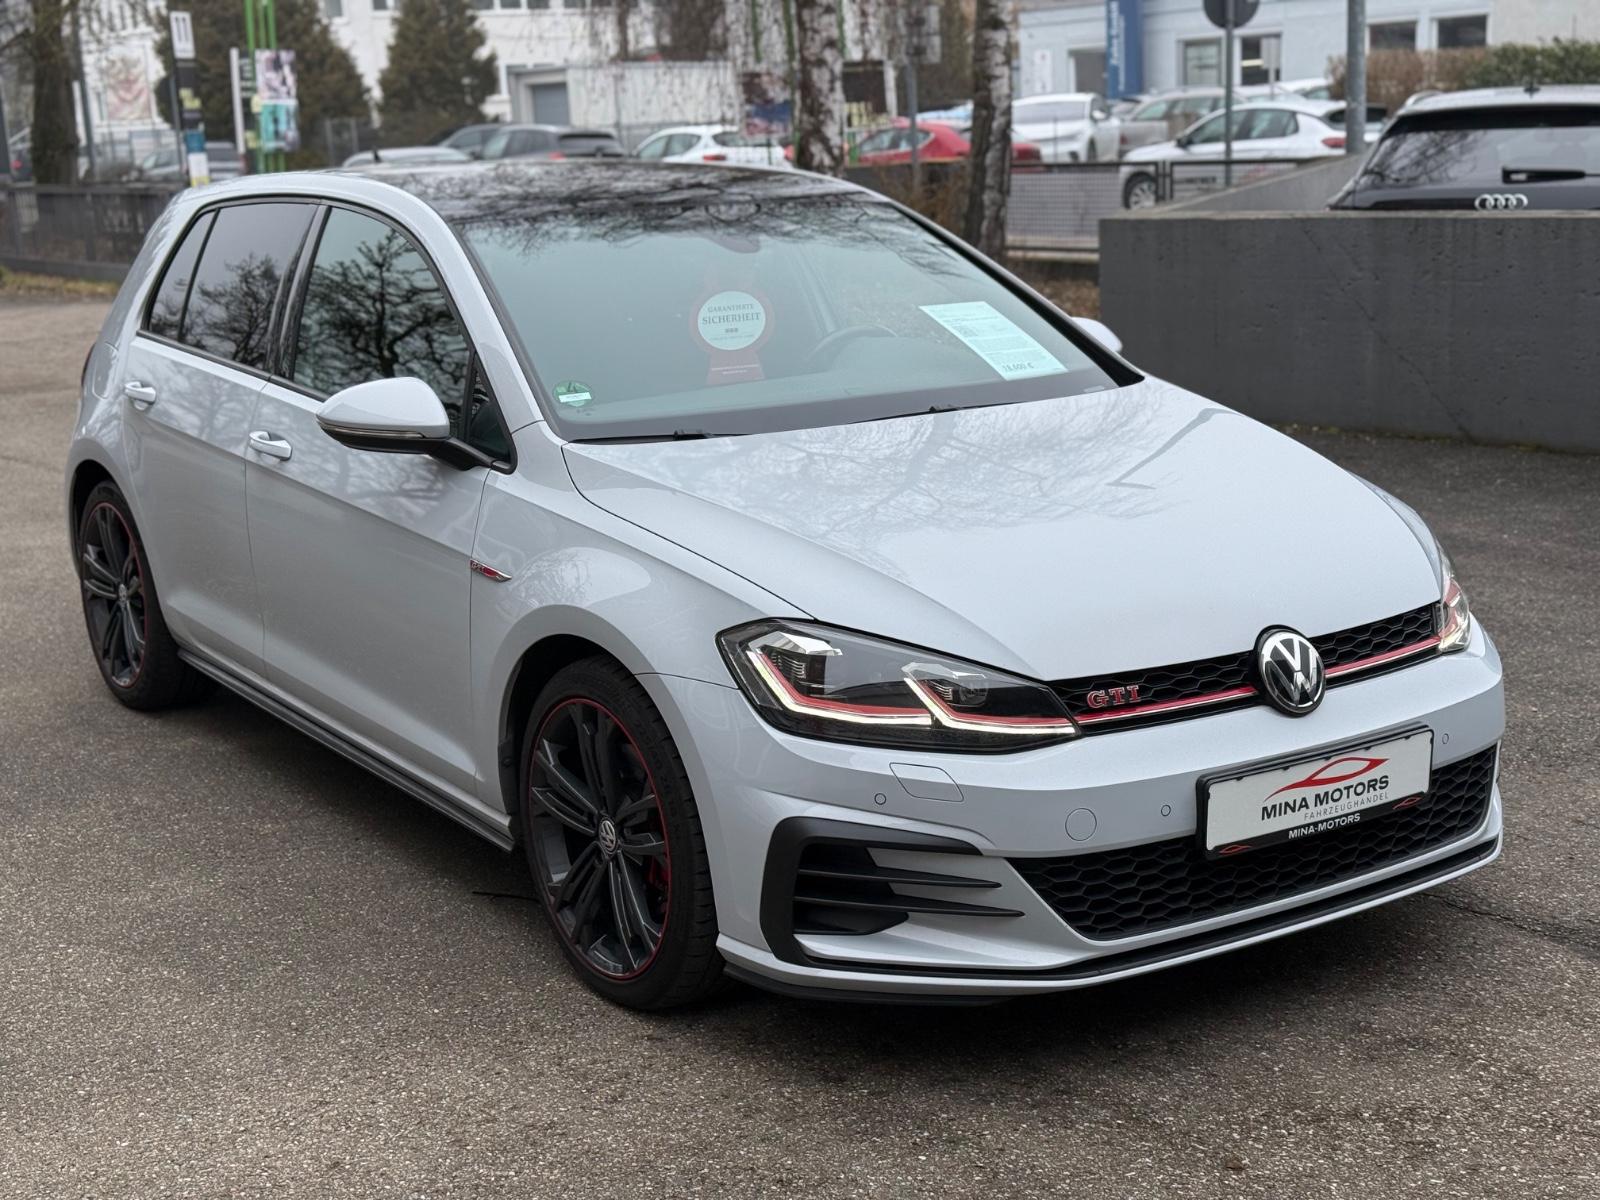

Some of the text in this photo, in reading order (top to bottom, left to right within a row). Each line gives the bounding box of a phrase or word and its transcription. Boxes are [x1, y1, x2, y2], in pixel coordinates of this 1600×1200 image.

[701, 312, 761, 325] SICHERHEIT
[1087, 684, 1140, 708] GTI
[1261, 775, 1389, 821] MINA MOTORS
[1304, 792, 1389, 821] FAHRZEUGHANDEL
[1288, 812, 1361, 840] MINA-MOTORS
